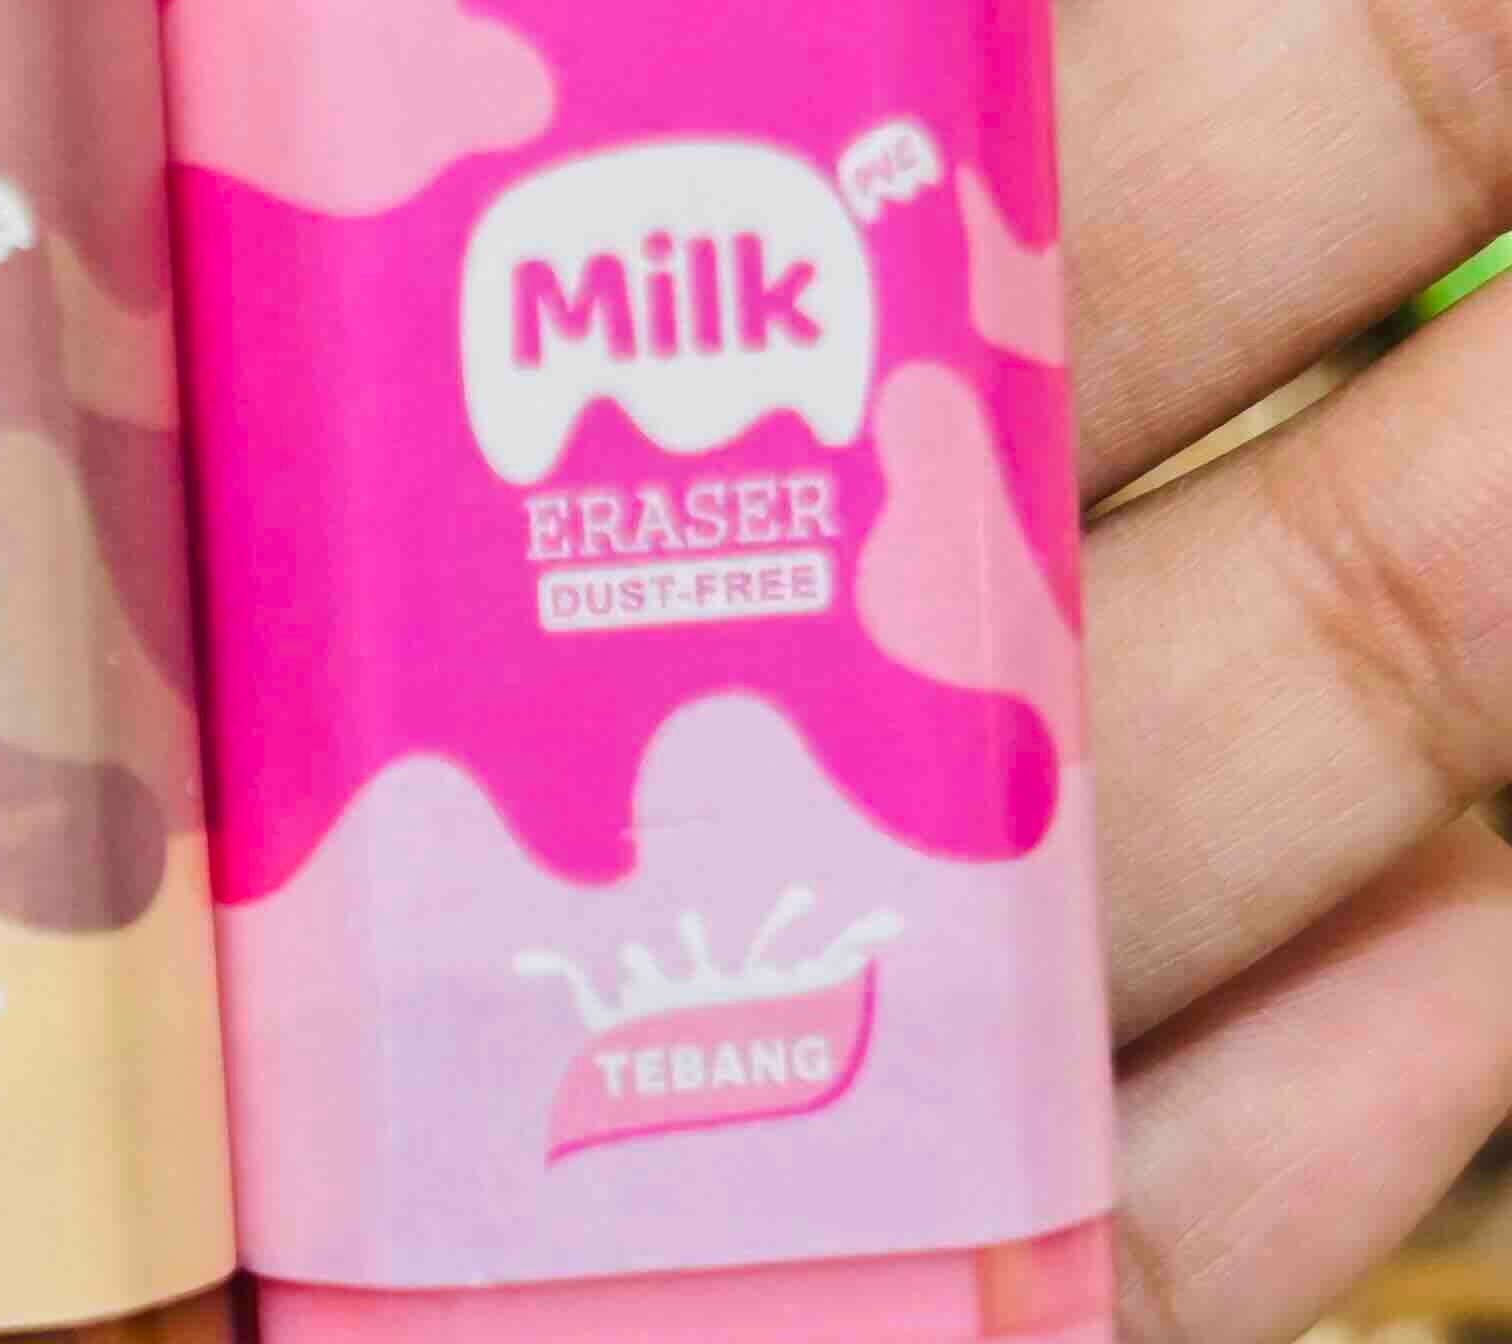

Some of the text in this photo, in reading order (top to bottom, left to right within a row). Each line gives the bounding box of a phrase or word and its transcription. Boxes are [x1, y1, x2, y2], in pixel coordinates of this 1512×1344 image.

[512, 229, 824, 369] Milk
[523, 475, 839, 561] ERASER
[550, 564, 816, 618] DUST-FREE
[594, 1034, 833, 1099] TEBANG
